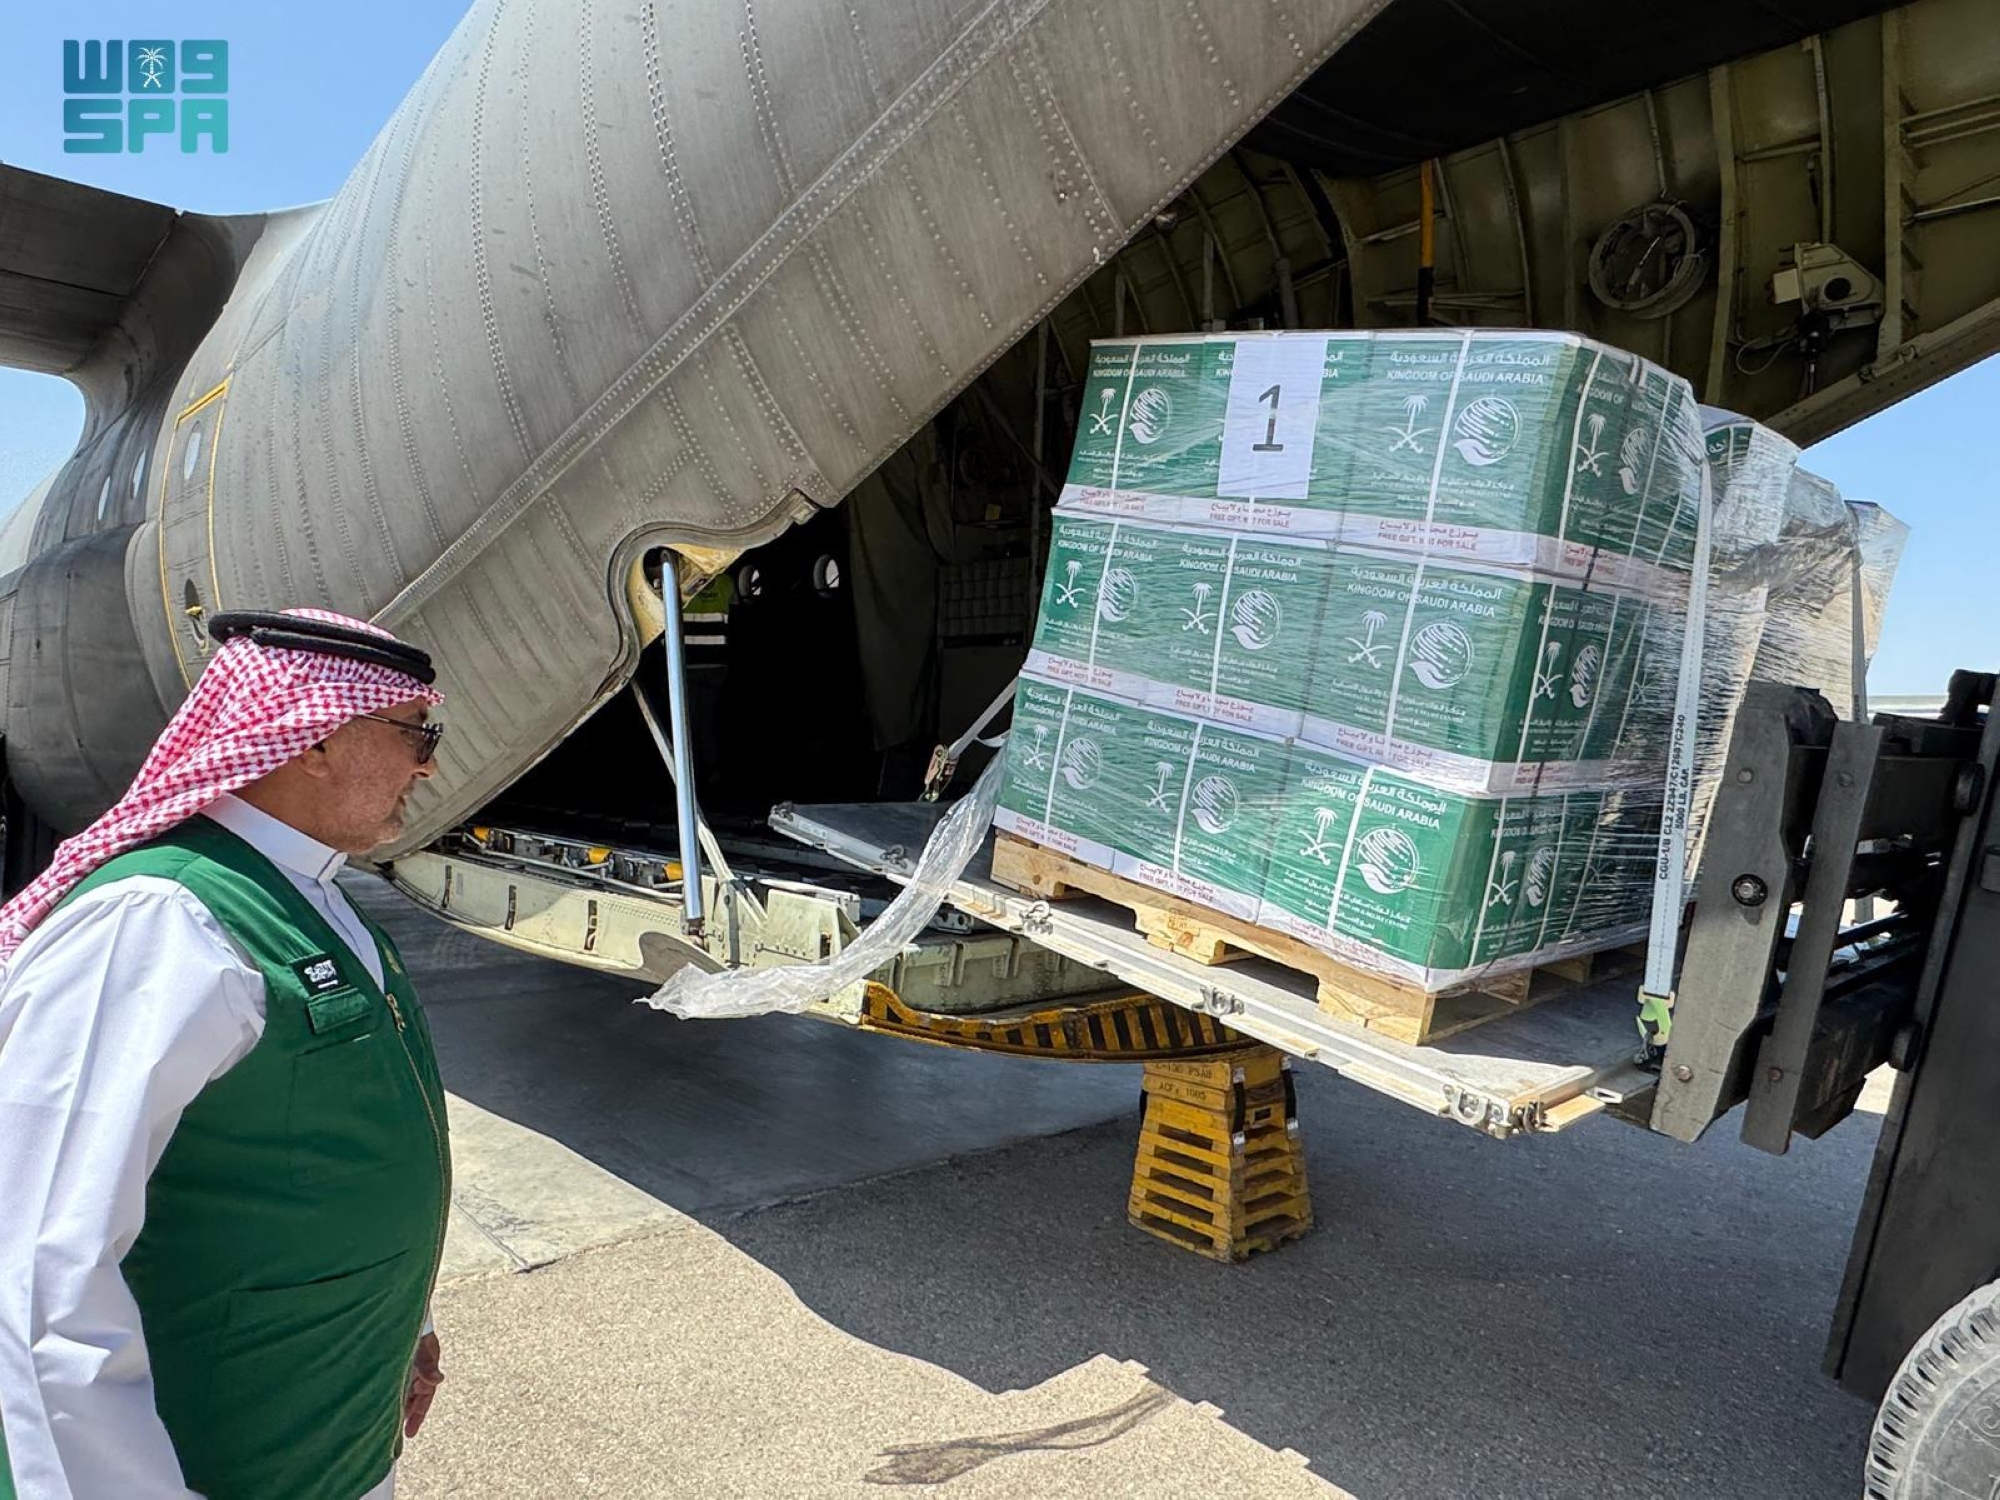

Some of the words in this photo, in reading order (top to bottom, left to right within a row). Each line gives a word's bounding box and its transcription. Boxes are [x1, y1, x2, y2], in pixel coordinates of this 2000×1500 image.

[1389, 351, 1448, 365] السعودية
[1449, 352, 1495, 366] العربة
[1496, 353, 1550, 366] المملكة
[1387, 369, 1437, 381] KINGDOM
[1460, 371, 1493, 383] SAUDI
[1497, 371, 1544, 384] ARABIA
[1252, 384, 1285, 452] 1
[1182, 543, 1226, 557] السعودية
[1419, 536, 1435, 545] NT
[1227, 549, 1260, 562] العربة
[1261, 551, 1303, 566] المملكة
[1179, 558, 1220, 572] KINGDOM
[1233, 566, 1260, 578] SAUDI
[1261, 570, 1298, 583] ARABIA
[1350, 566, 1406, 586] السعودية
[1406, 573, 1448, 590] العربة
[1450, 580, 1502, 600] المملكة
[1347, 582, 1395, 600] KINGDOM
[1415, 593, 1449, 610] SAUDI
[1450, 600, 1496, 618] ARABIA
[1147, 720, 1190, 740] السعودية
[1188, 731, 1220, 748] العربة
[1143, 736, 1181, 753] KINGDOM
[1220, 757, 1256, 774] ARABIA
[1221, 737, 1260, 758] المملكة
[1305, 759, 1357, 785] السعودية
[1357, 778, 1396, 797] العربة
[1300, 778, 1346, 800] KINGDOM
[1363, 797, 1395, 816] SAUDI
[1397, 808, 1440, 830] ARABIA
[1397, 791, 1447, 815] المملكة
